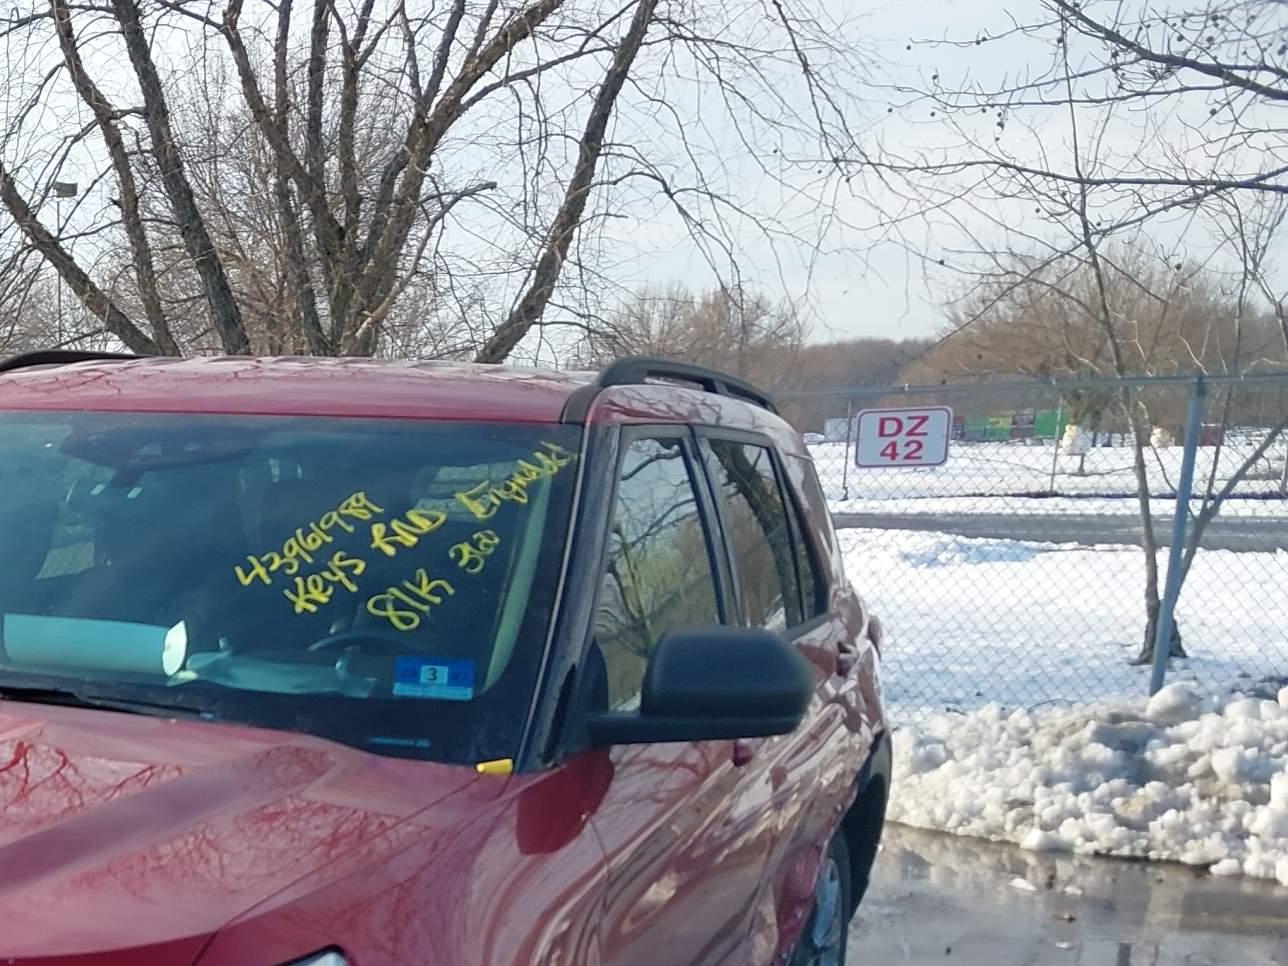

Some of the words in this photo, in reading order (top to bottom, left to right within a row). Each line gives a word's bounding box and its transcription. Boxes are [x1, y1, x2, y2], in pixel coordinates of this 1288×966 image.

[878, 415, 930, 438] DZ
[878, 439, 924, 461] 42
[235, 491, 385, 586] 43961989
[426, 666, 439, 682] 3
